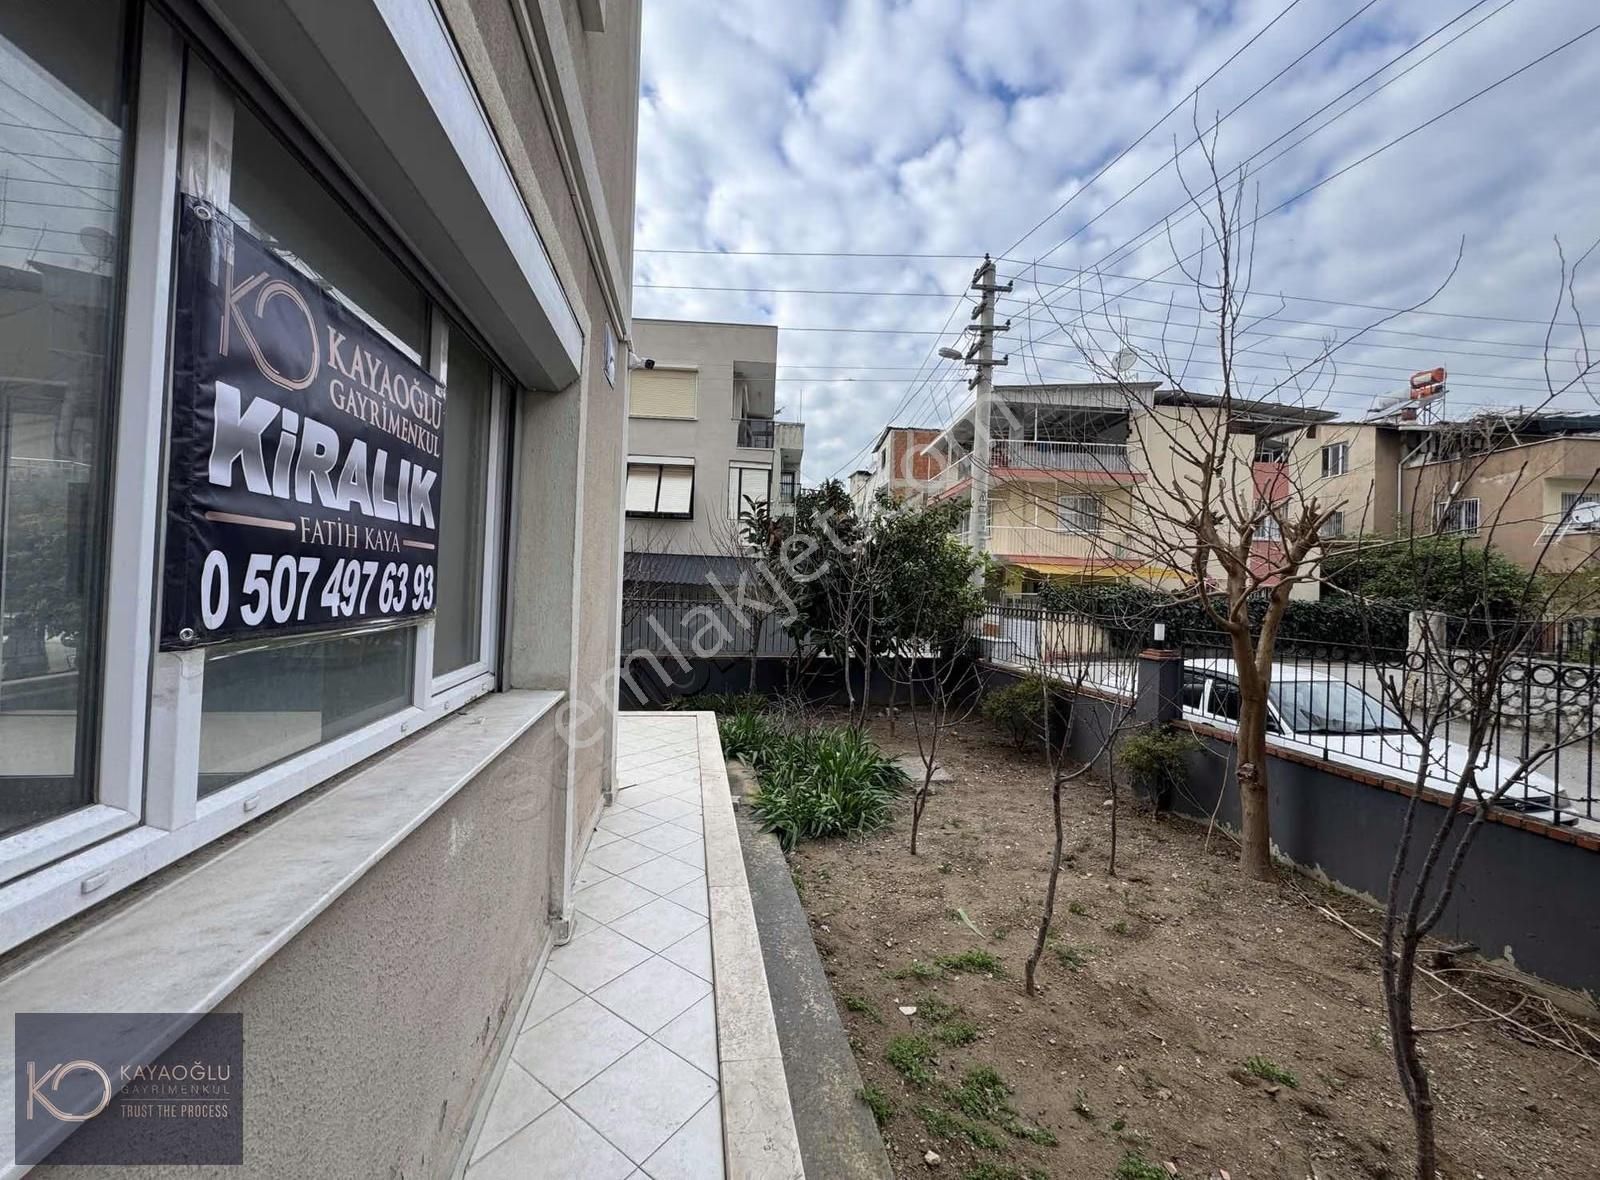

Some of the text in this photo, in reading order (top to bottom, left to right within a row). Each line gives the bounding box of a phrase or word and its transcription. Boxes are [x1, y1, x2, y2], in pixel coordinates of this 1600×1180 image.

[326, 325, 443, 431] KAYAOĞLU
[328, 379, 442, 458] GAYRİMENKUL
[299, 516, 401, 553] FATİH KAYA
[200, 550, 435, 630] 0 507 497 63 93
